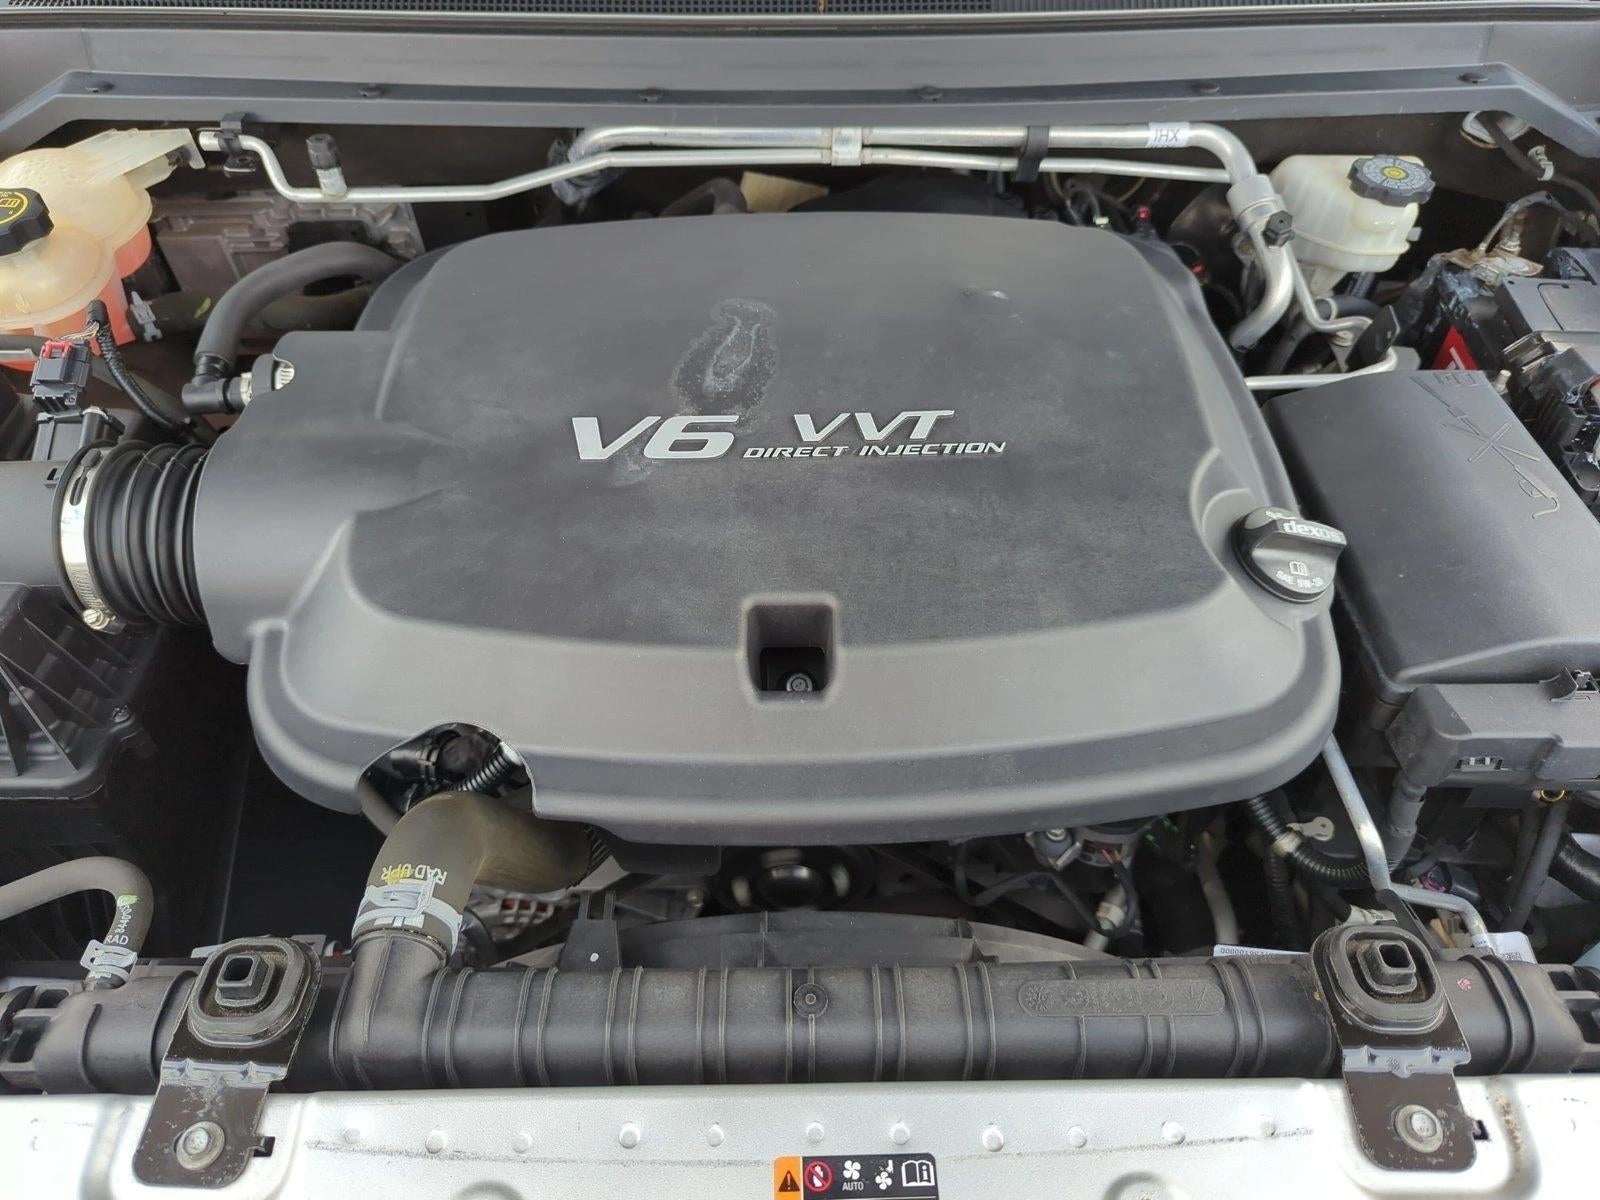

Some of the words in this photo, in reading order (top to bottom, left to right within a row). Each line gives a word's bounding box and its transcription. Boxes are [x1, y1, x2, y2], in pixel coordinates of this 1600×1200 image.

[794, 410, 955, 441] VVT
[572, 415, 740, 459] V6
[742, 445, 849, 458] DIRECT
[859, 441, 1006, 457] INJECTION
[1283, 520, 1344, 542] dexos
[1276, 570, 1293, 584] SAE
[415, 865, 447, 885] RAD
[104, 934, 128, 945] RAD
[842, 1182, 863, 1191] AUTO
